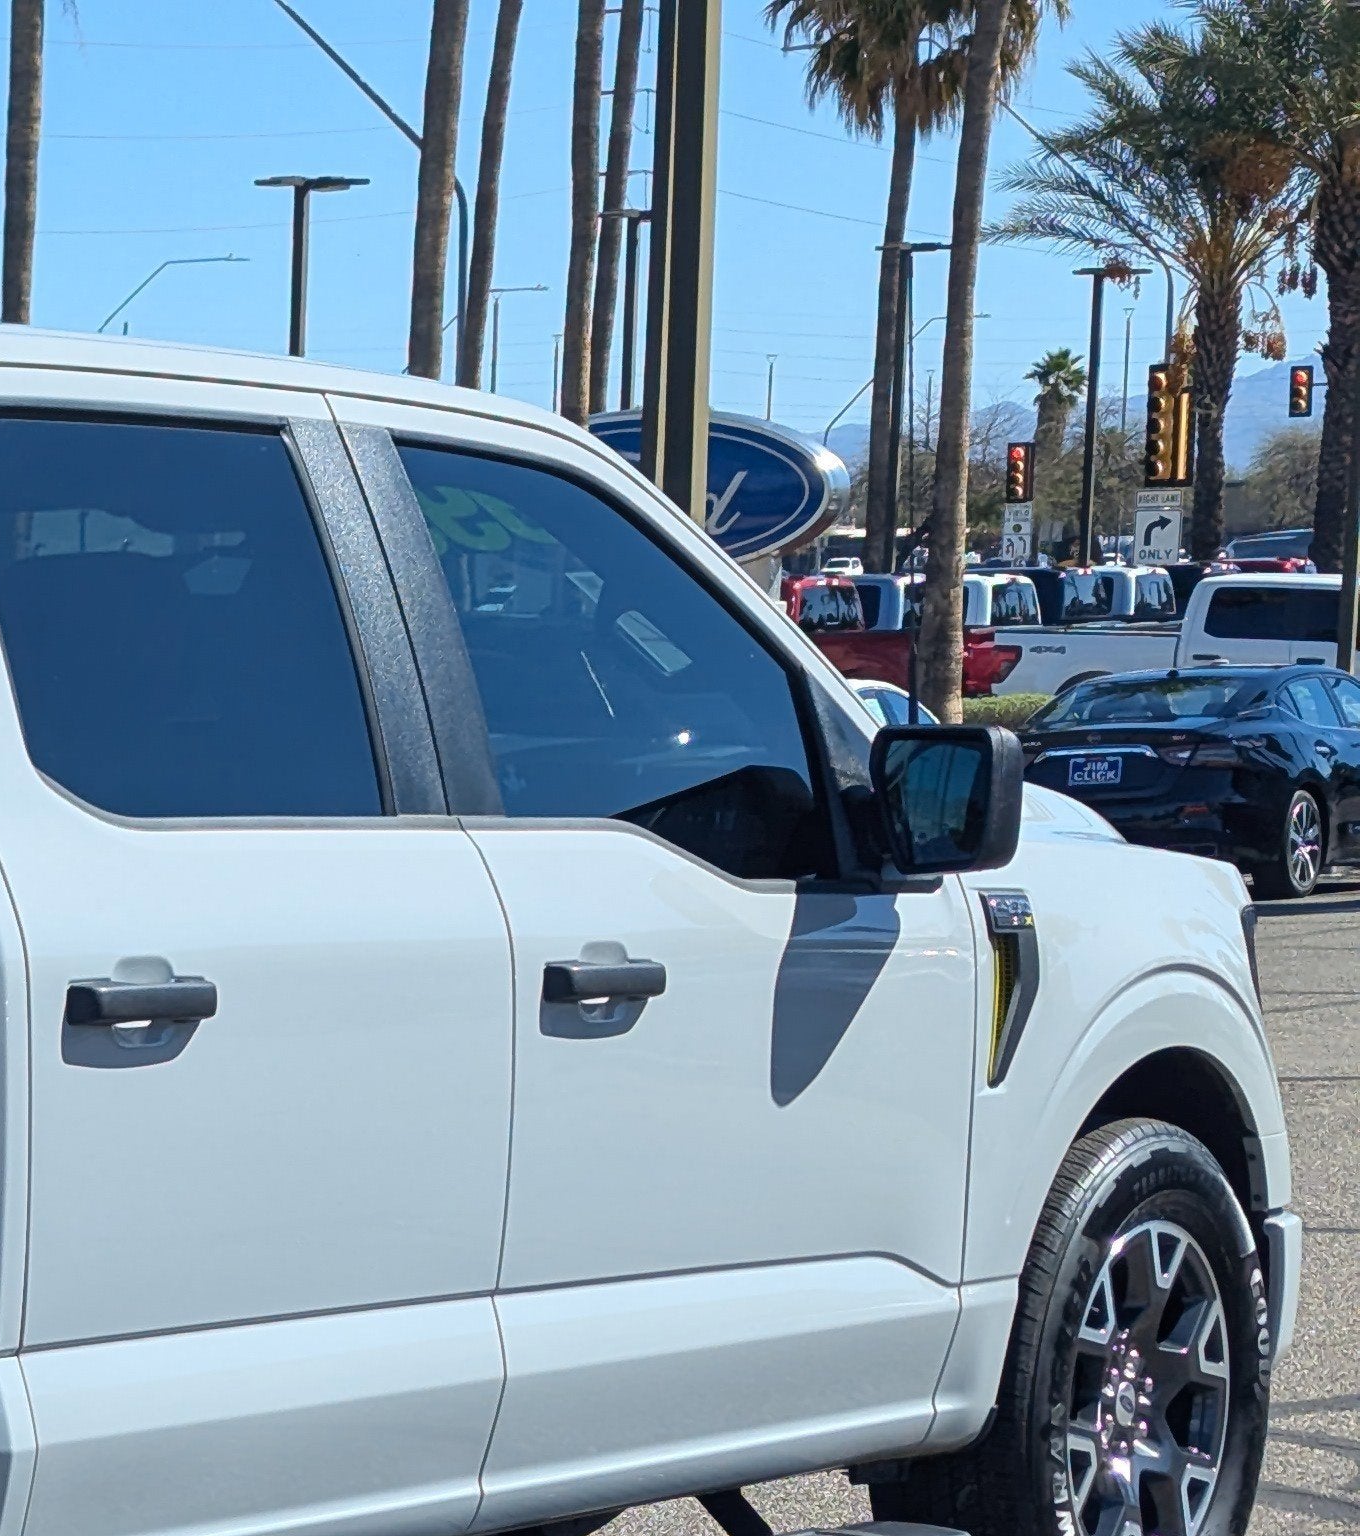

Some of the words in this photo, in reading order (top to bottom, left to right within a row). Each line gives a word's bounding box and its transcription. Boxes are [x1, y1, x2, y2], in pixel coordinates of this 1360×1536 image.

[1139, 548, 1173, 560] ONLY
[1083, 761, 1109, 771] JIM
[1074, 769, 1118, 781] CLICK
